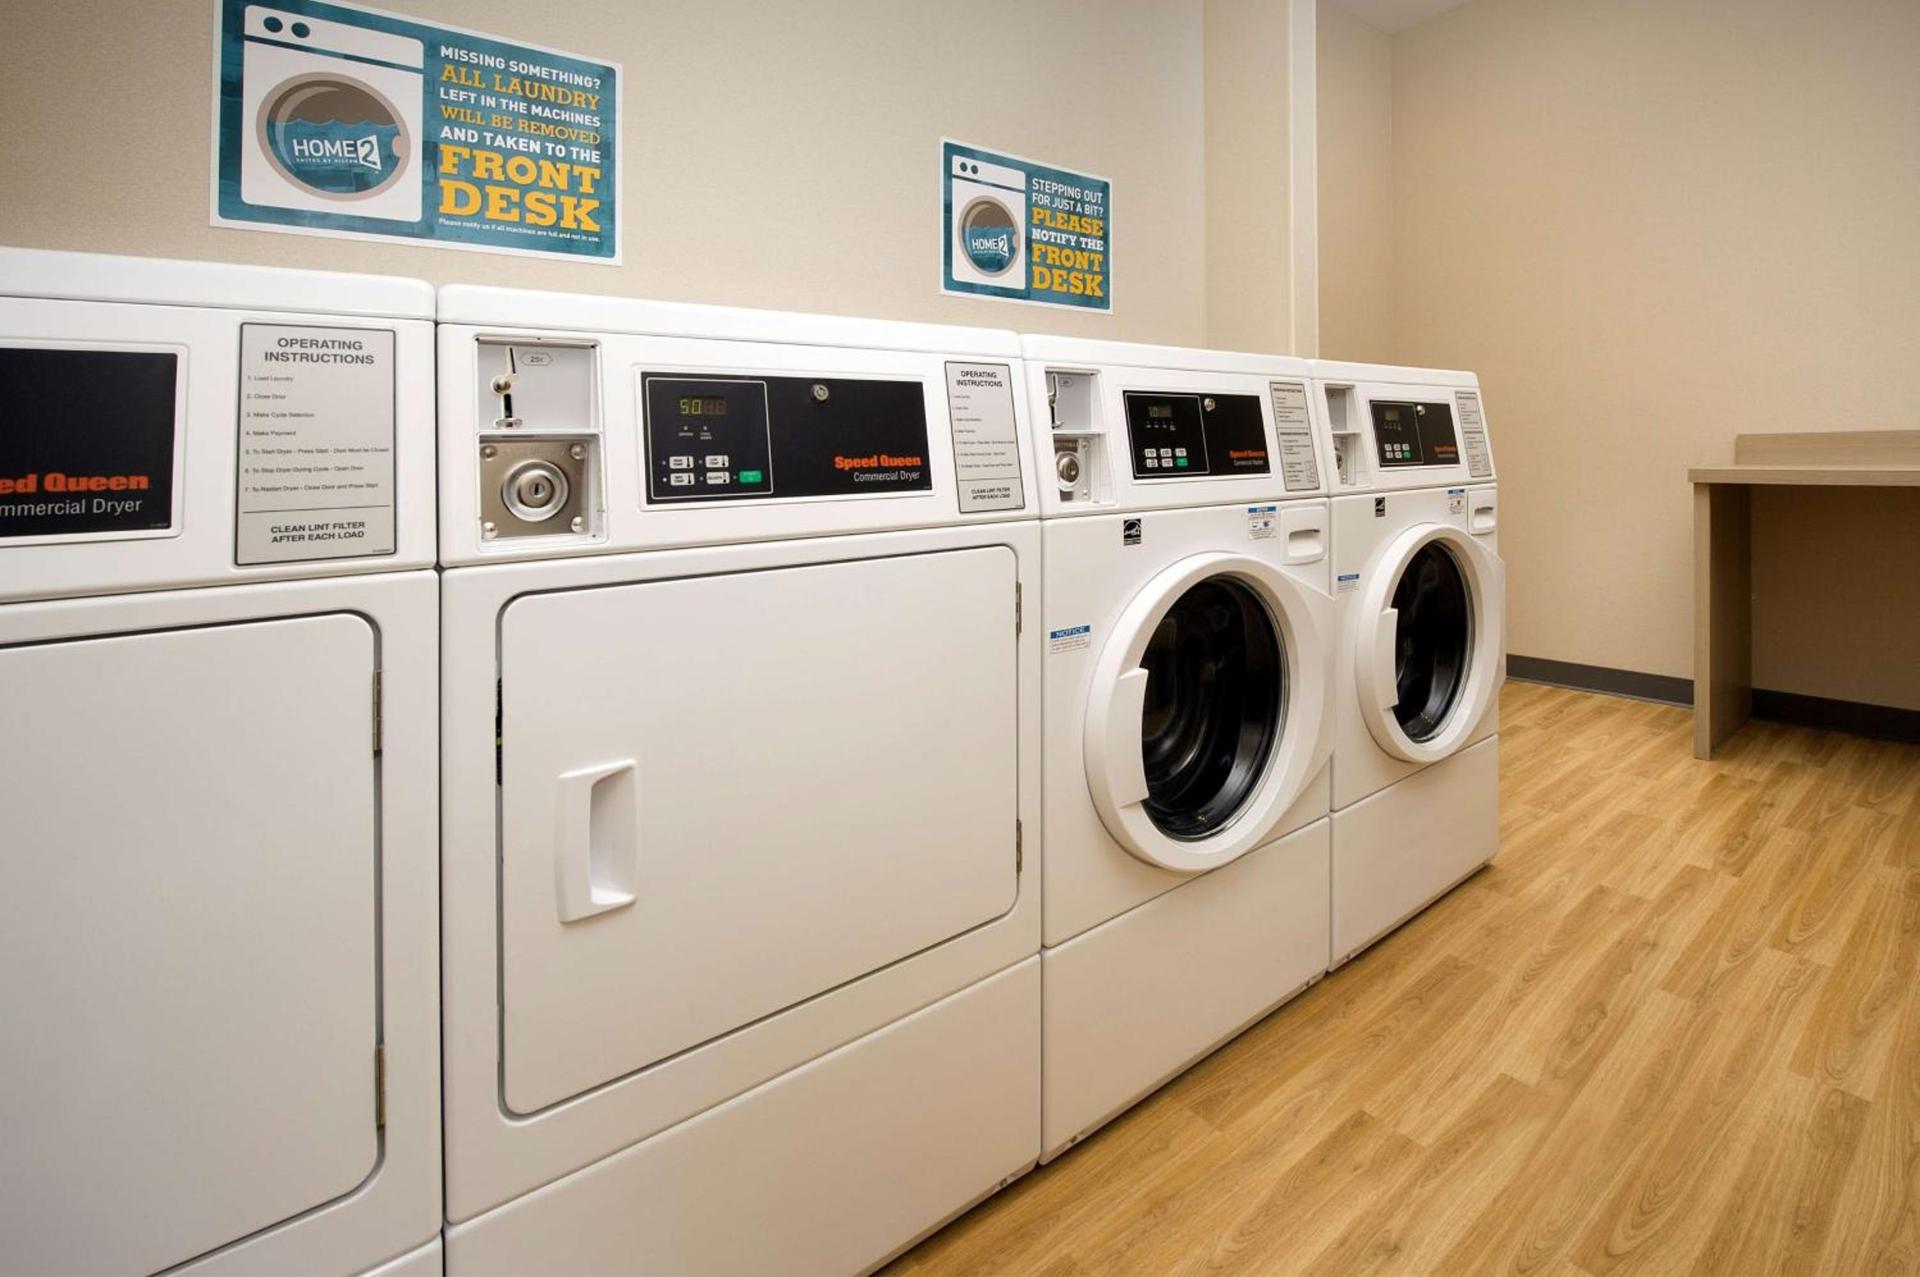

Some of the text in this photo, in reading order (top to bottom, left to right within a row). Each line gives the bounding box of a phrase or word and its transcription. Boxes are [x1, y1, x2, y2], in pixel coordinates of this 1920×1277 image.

[441, 46, 600, 89] MISSING SOMETHING?
[441, 64, 600, 110] ALL LAUNDRY
[440, 87, 600, 126] LEFT IN THE MACHINES
[441, 105, 600, 144] WILL BE REMOVED
[440, 125, 601, 163] AND TAKEN TO THE
[439, 144, 600, 194] FRONT
[1032, 178, 1103, 203] STEPPING OUT
[438, 178, 600, 232] DESK
[1032, 193, 1104, 217] FOR JUST A BIT?
[1032, 207, 1103, 237] PLEASE
[1032, 228, 1103, 251] NOTIFY THE
[1032, 243, 1103, 272] FRONT
[1032, 266, 1103, 297] DESK
[277, 338, 363, 350] OPERATING
[264, 352, 374, 364] INSTRUCTIONS
[835, 455, 922, 470] Speed Queen
[43, 472, 149, 492] Queen
[854, 471, 920, 481] Commercial Dryer
[93, 498, 143, 515] Dryer
[271, 521, 365, 534] CLEAN LINT FILTER
[272, 530, 364, 543] AFTER EACH LOAD
